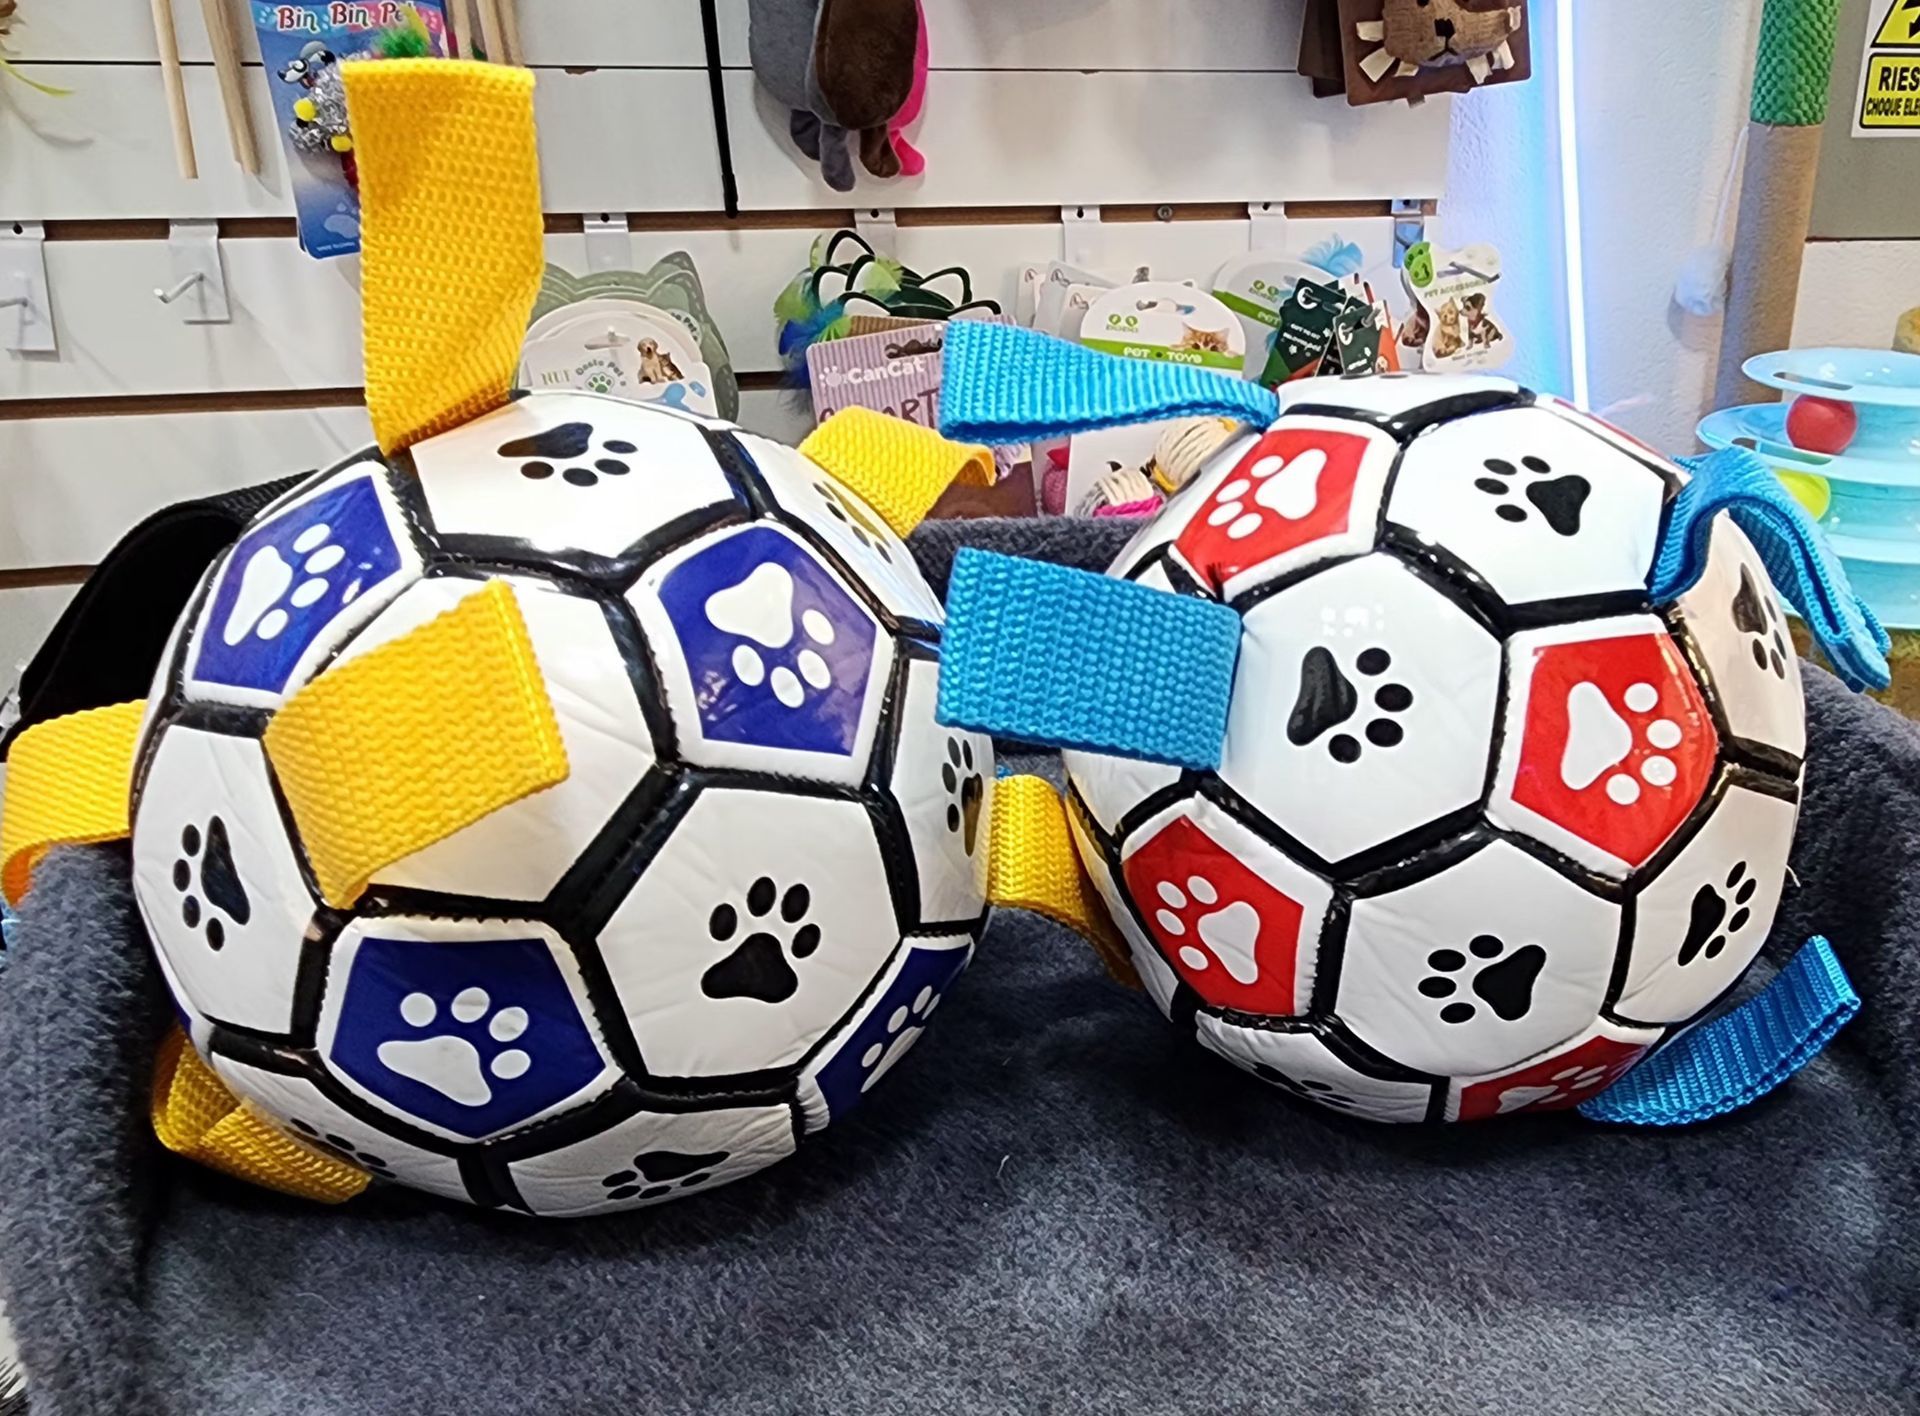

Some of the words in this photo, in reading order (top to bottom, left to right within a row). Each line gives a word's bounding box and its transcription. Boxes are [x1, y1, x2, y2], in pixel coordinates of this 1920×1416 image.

[277, 6, 317, 32] Bin
[331, 2, 370, 27] Bin
[1866, 97, 1902, 116] CHOQUE
[1166, 351, 1202, 364] TOYS
[848, 356, 926, 384] CanCat
